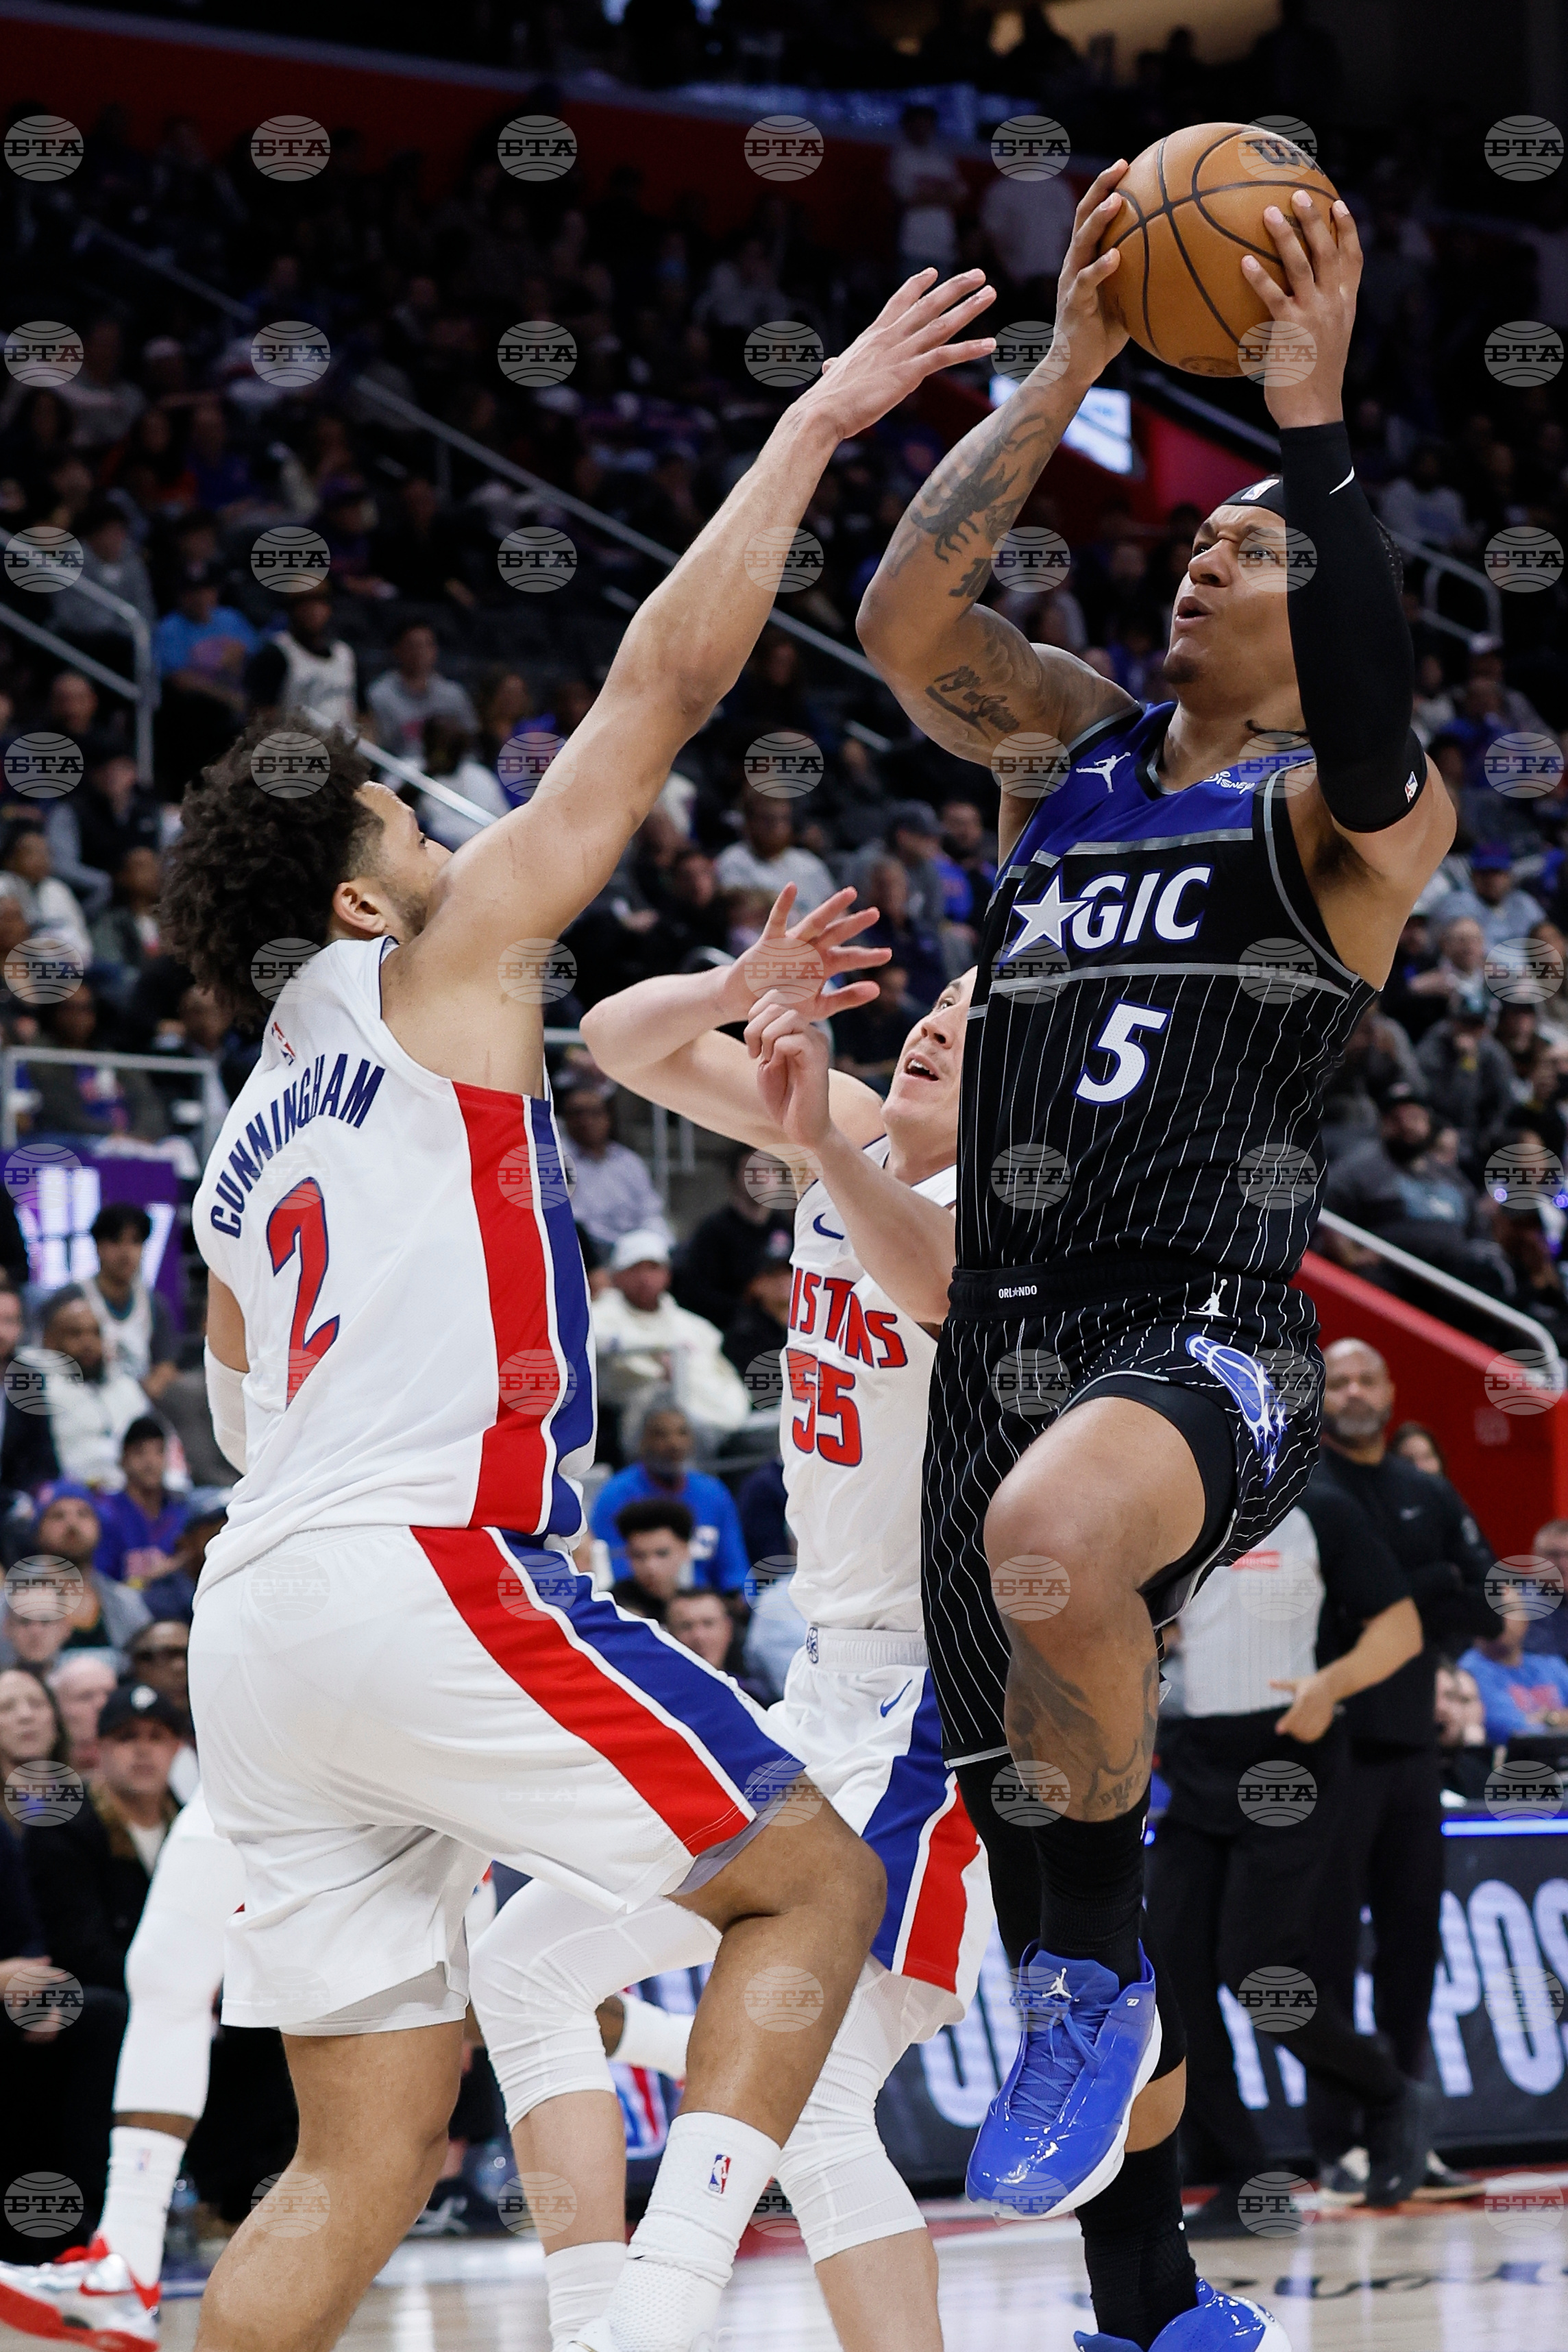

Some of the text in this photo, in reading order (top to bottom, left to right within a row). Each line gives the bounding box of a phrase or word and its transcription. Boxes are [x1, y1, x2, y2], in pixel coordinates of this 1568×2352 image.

[1073, 998, 1173, 1108] 5
[210, 1054, 385, 1239] CUNNINGHAM
[266, 1176, 340, 1410] 2
[785, 1348, 863, 1467] 55
